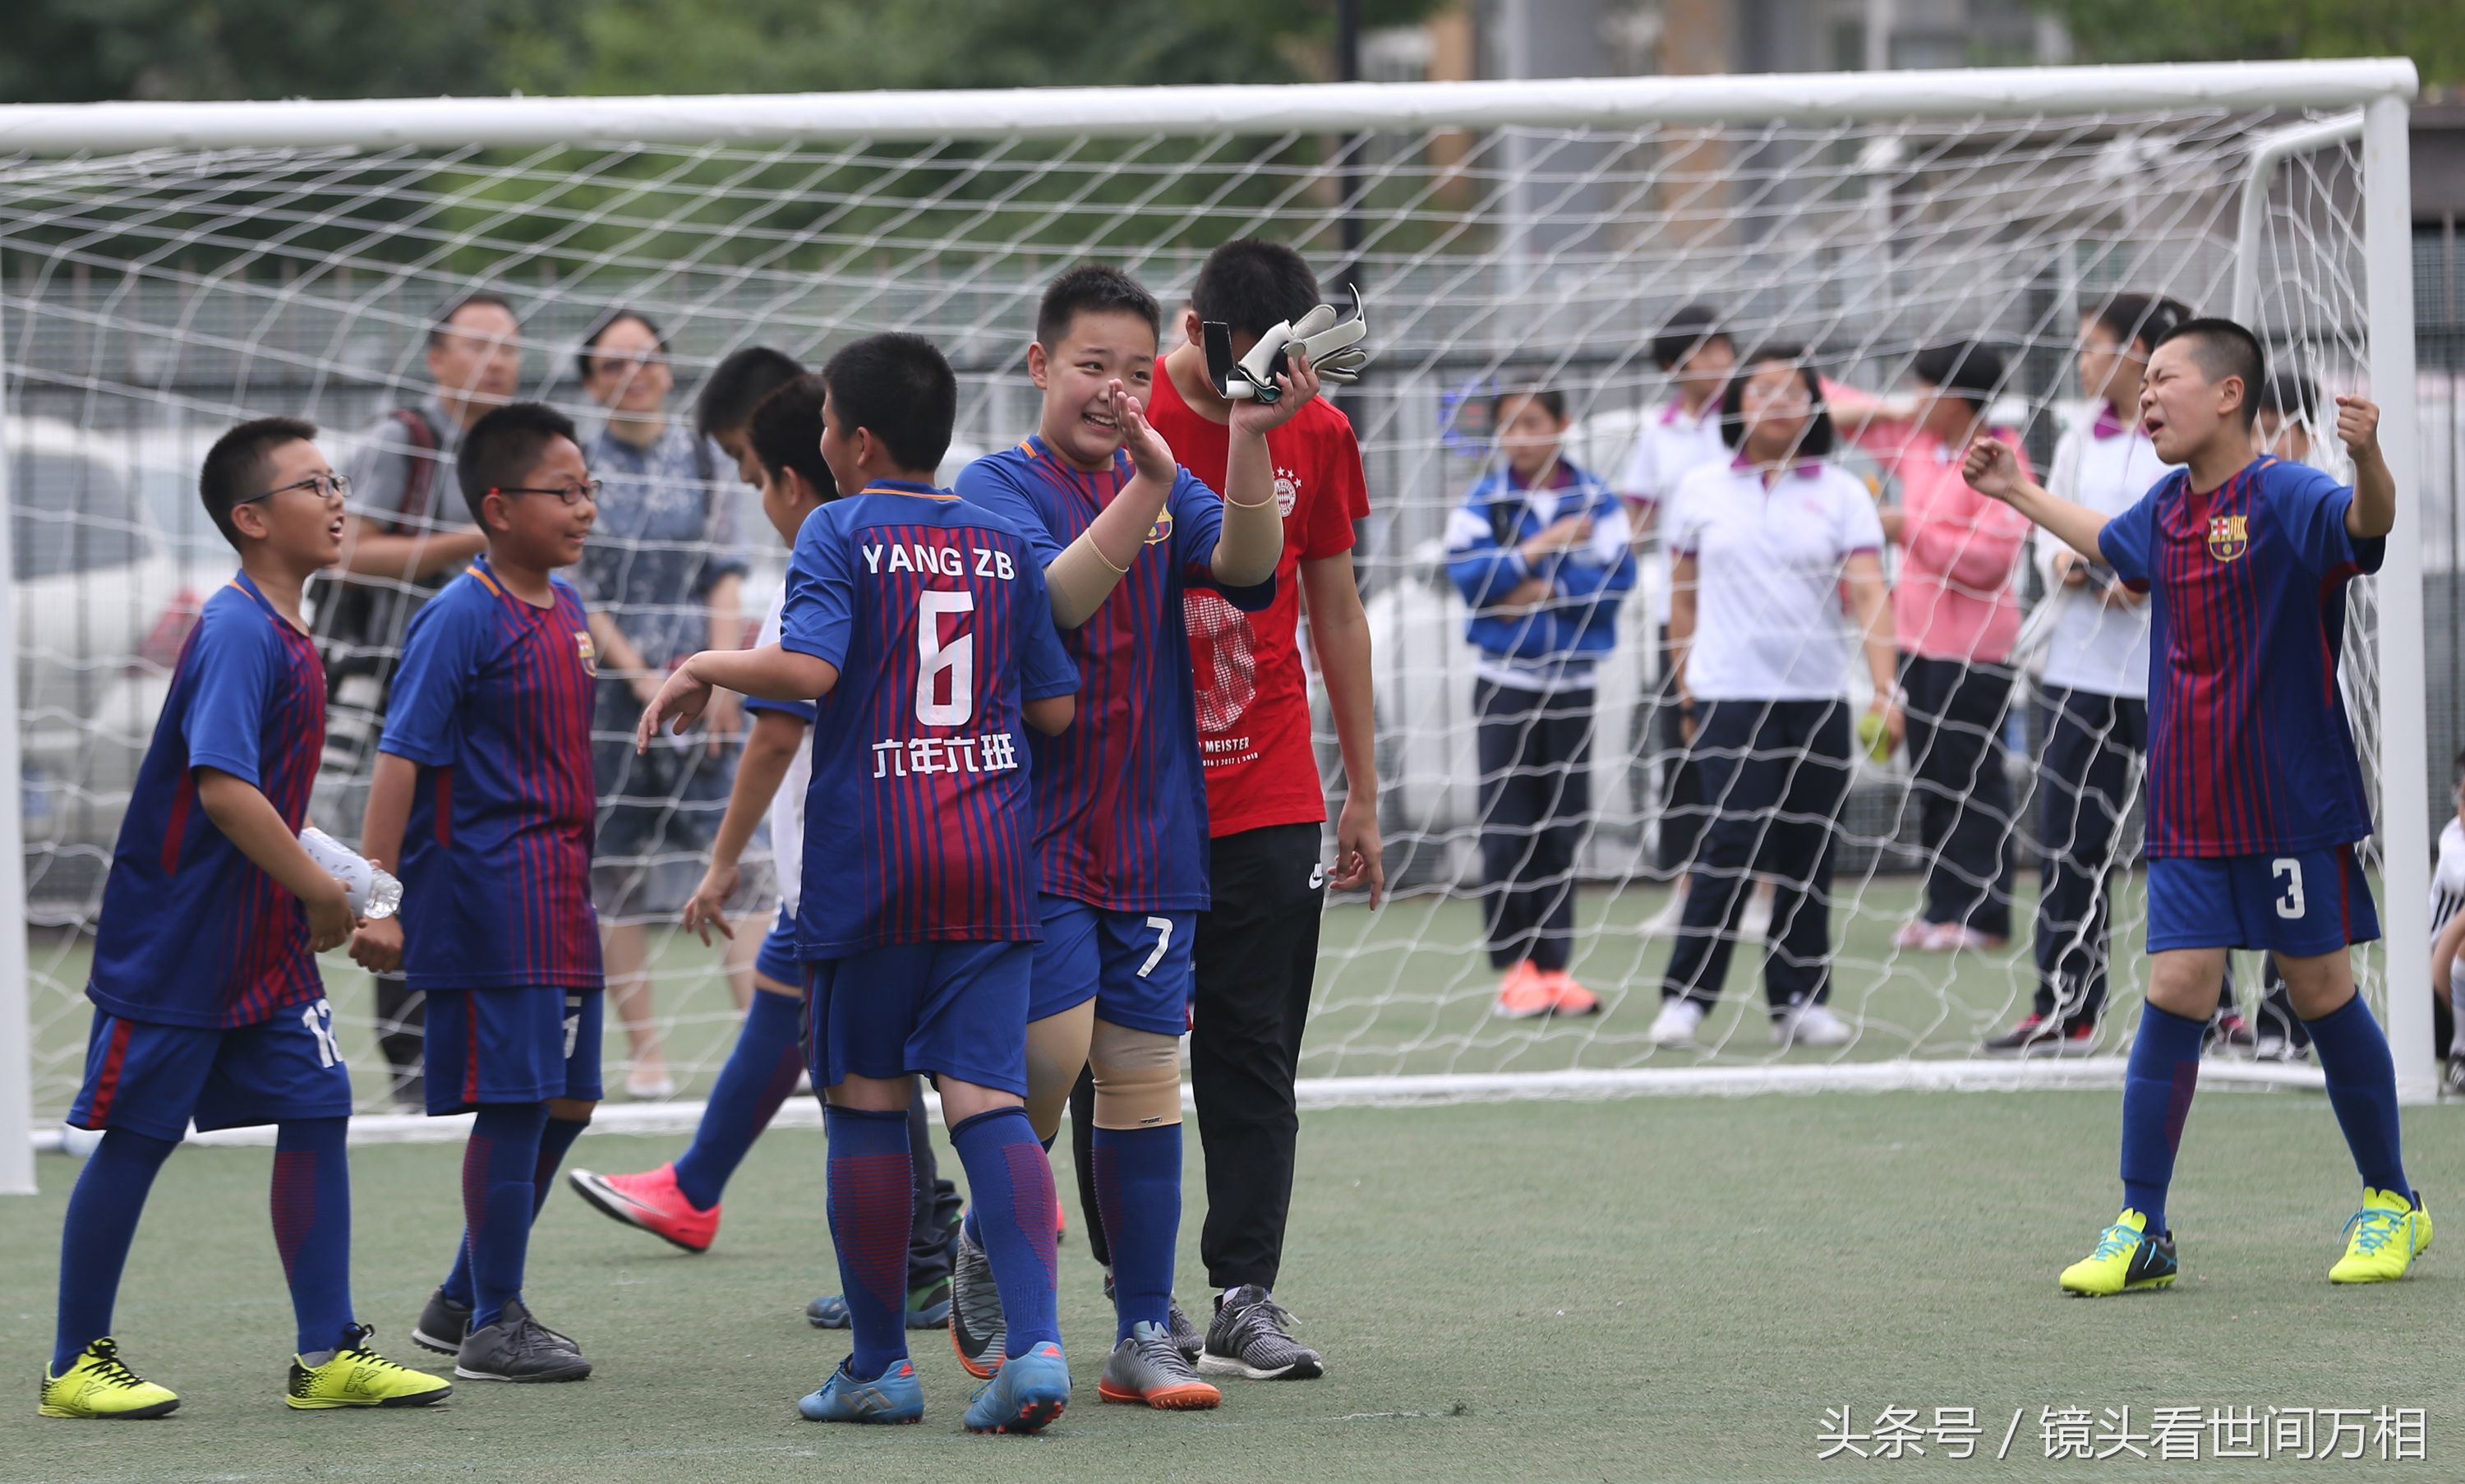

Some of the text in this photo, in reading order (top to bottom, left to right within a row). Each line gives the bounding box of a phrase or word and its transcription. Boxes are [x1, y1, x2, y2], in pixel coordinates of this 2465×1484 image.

[863, 544, 1016, 580] YANG ZB
[915, 590, 974, 726] 6
[872, 733, 1018, 779] 六年六班
[1205, 736, 1250, 753] MEISTER
[2272, 858, 2306, 919] 3
[1136, 916, 1173, 978] 7
